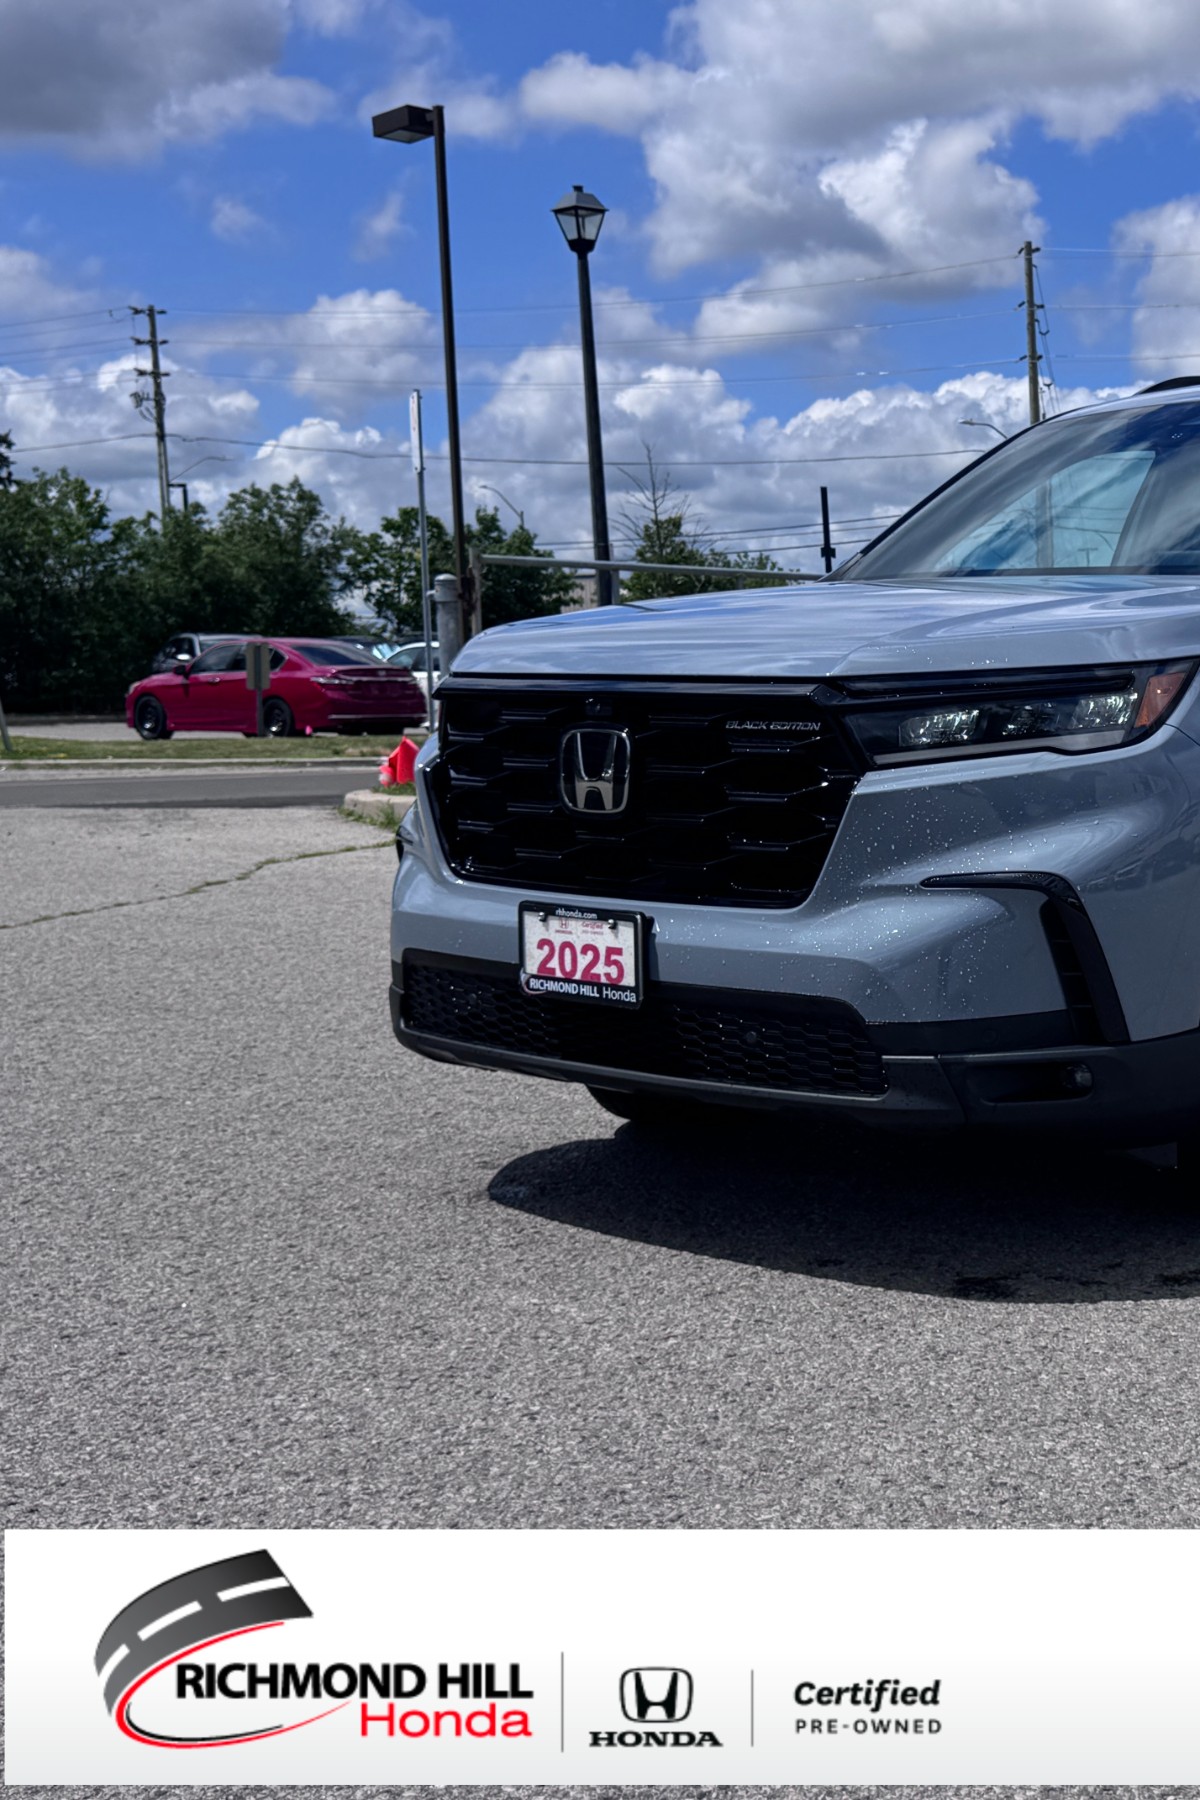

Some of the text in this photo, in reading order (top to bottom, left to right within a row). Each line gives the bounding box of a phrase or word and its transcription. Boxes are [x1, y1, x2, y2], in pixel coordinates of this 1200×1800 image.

[725, 720, 821, 731] BLACK EDITION
[555, 907, 598, 920] rhhonda.com
[536, 938, 625, 985] 2025
[529, 979, 637, 1002] RICHMOND HILL Honda
